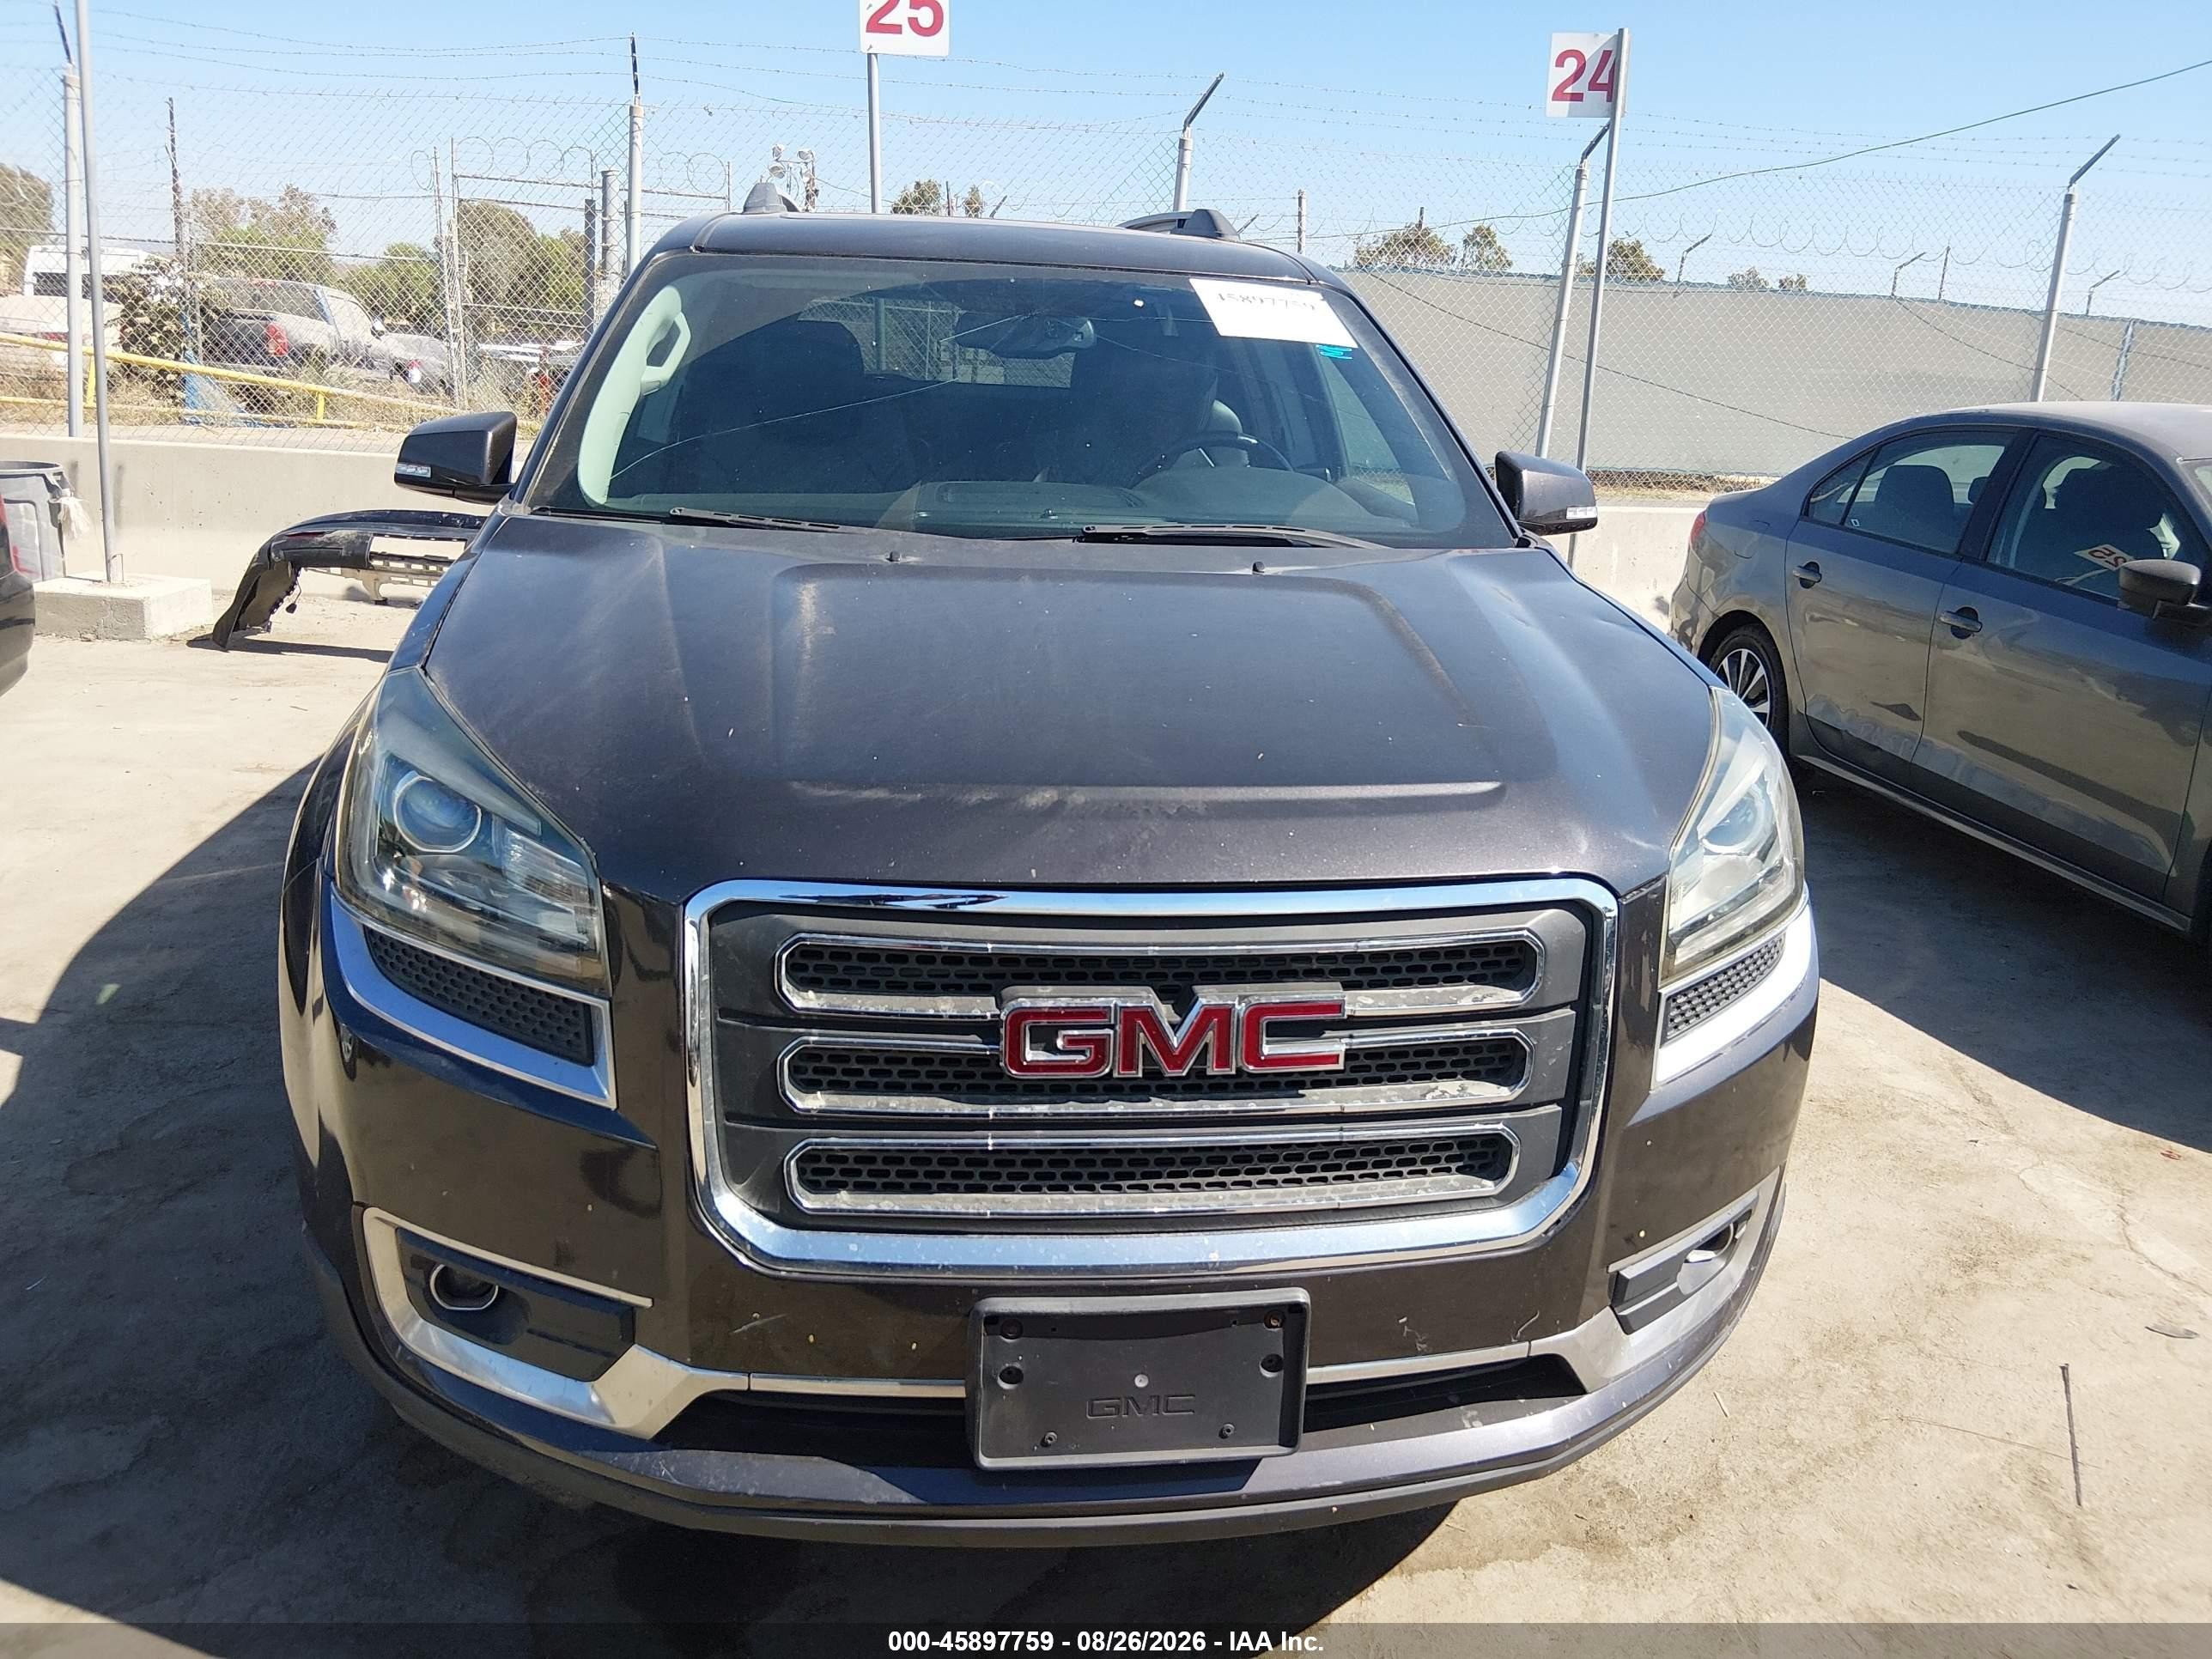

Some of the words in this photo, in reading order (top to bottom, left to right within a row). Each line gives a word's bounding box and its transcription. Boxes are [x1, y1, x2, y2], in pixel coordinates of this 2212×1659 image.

[866, 0, 944, 37] 25
[1552, 49, 1616, 102] 24
[1001, 994, 1347, 1079] GMC
[1085, 1394, 1196, 1419] GMC
